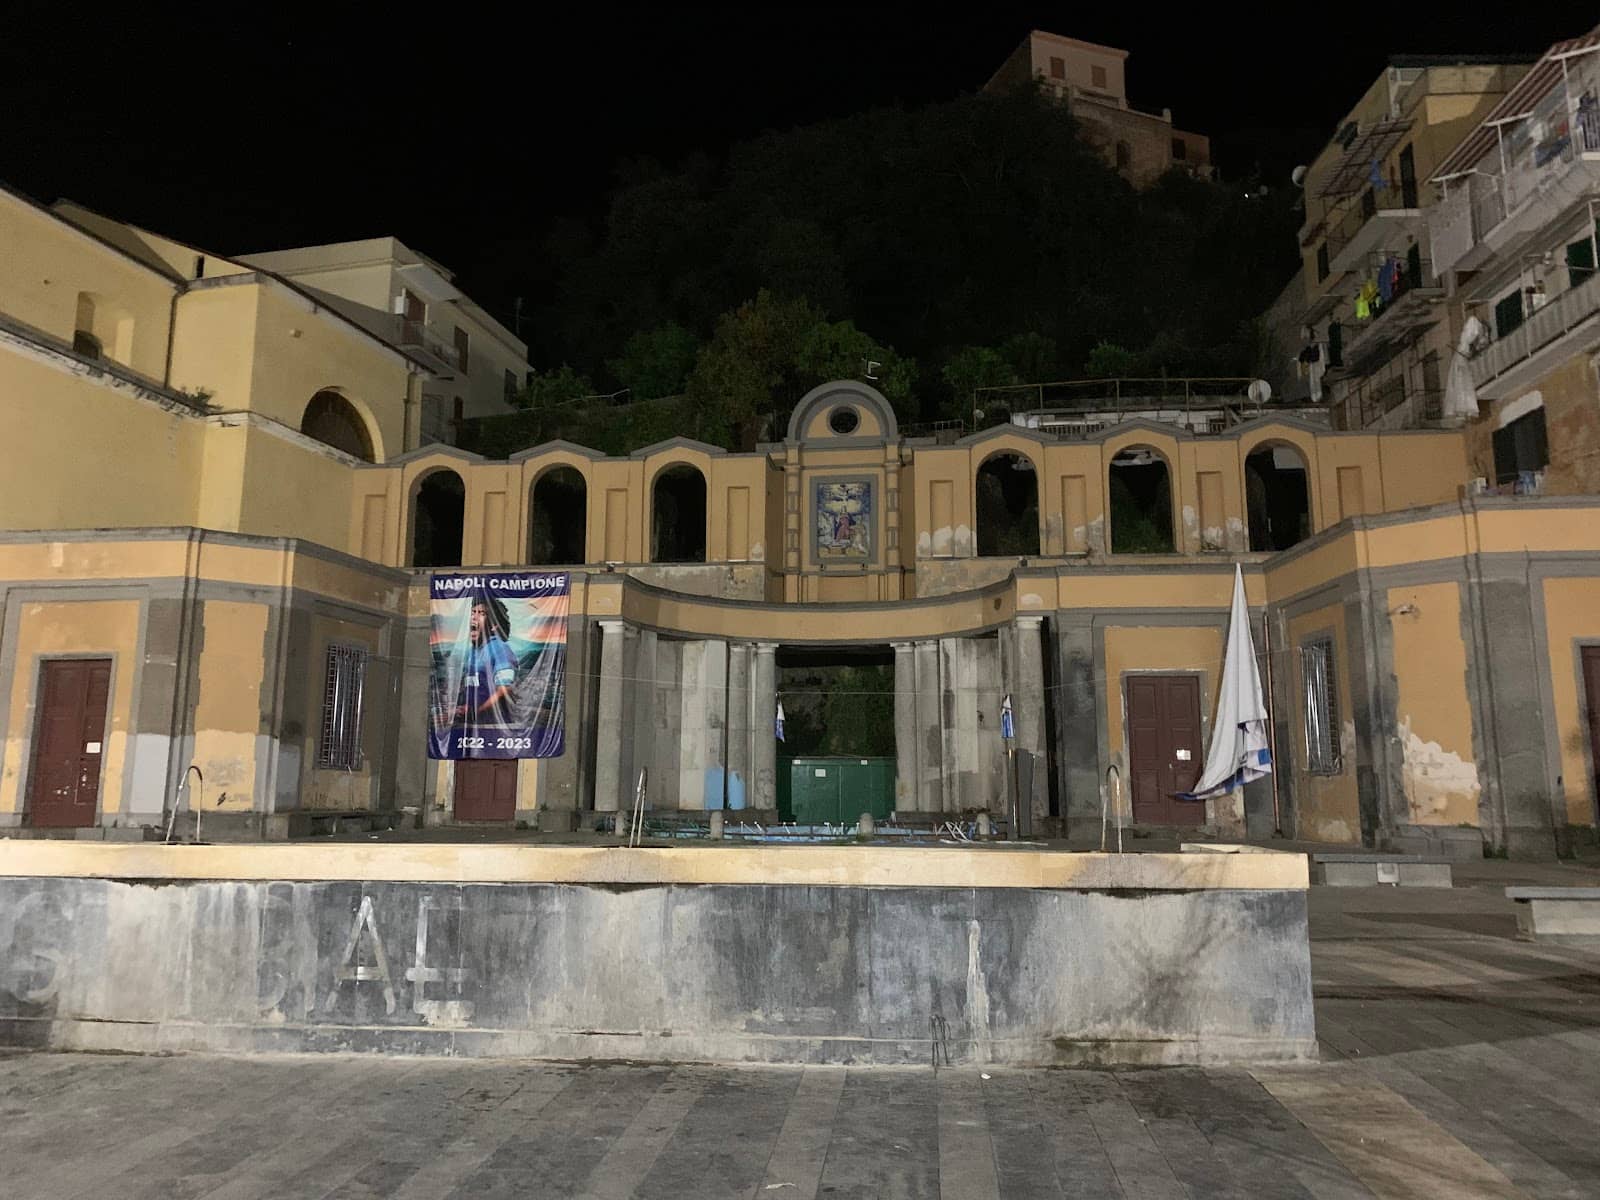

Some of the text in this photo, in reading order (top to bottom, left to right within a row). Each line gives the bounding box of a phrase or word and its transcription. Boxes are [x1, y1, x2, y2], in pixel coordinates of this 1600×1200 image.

[434, 576, 565, 590] NAPOLI CAMPIONE
[457, 737, 485, 749] 2022
[496, 737, 531, 749] 2023
